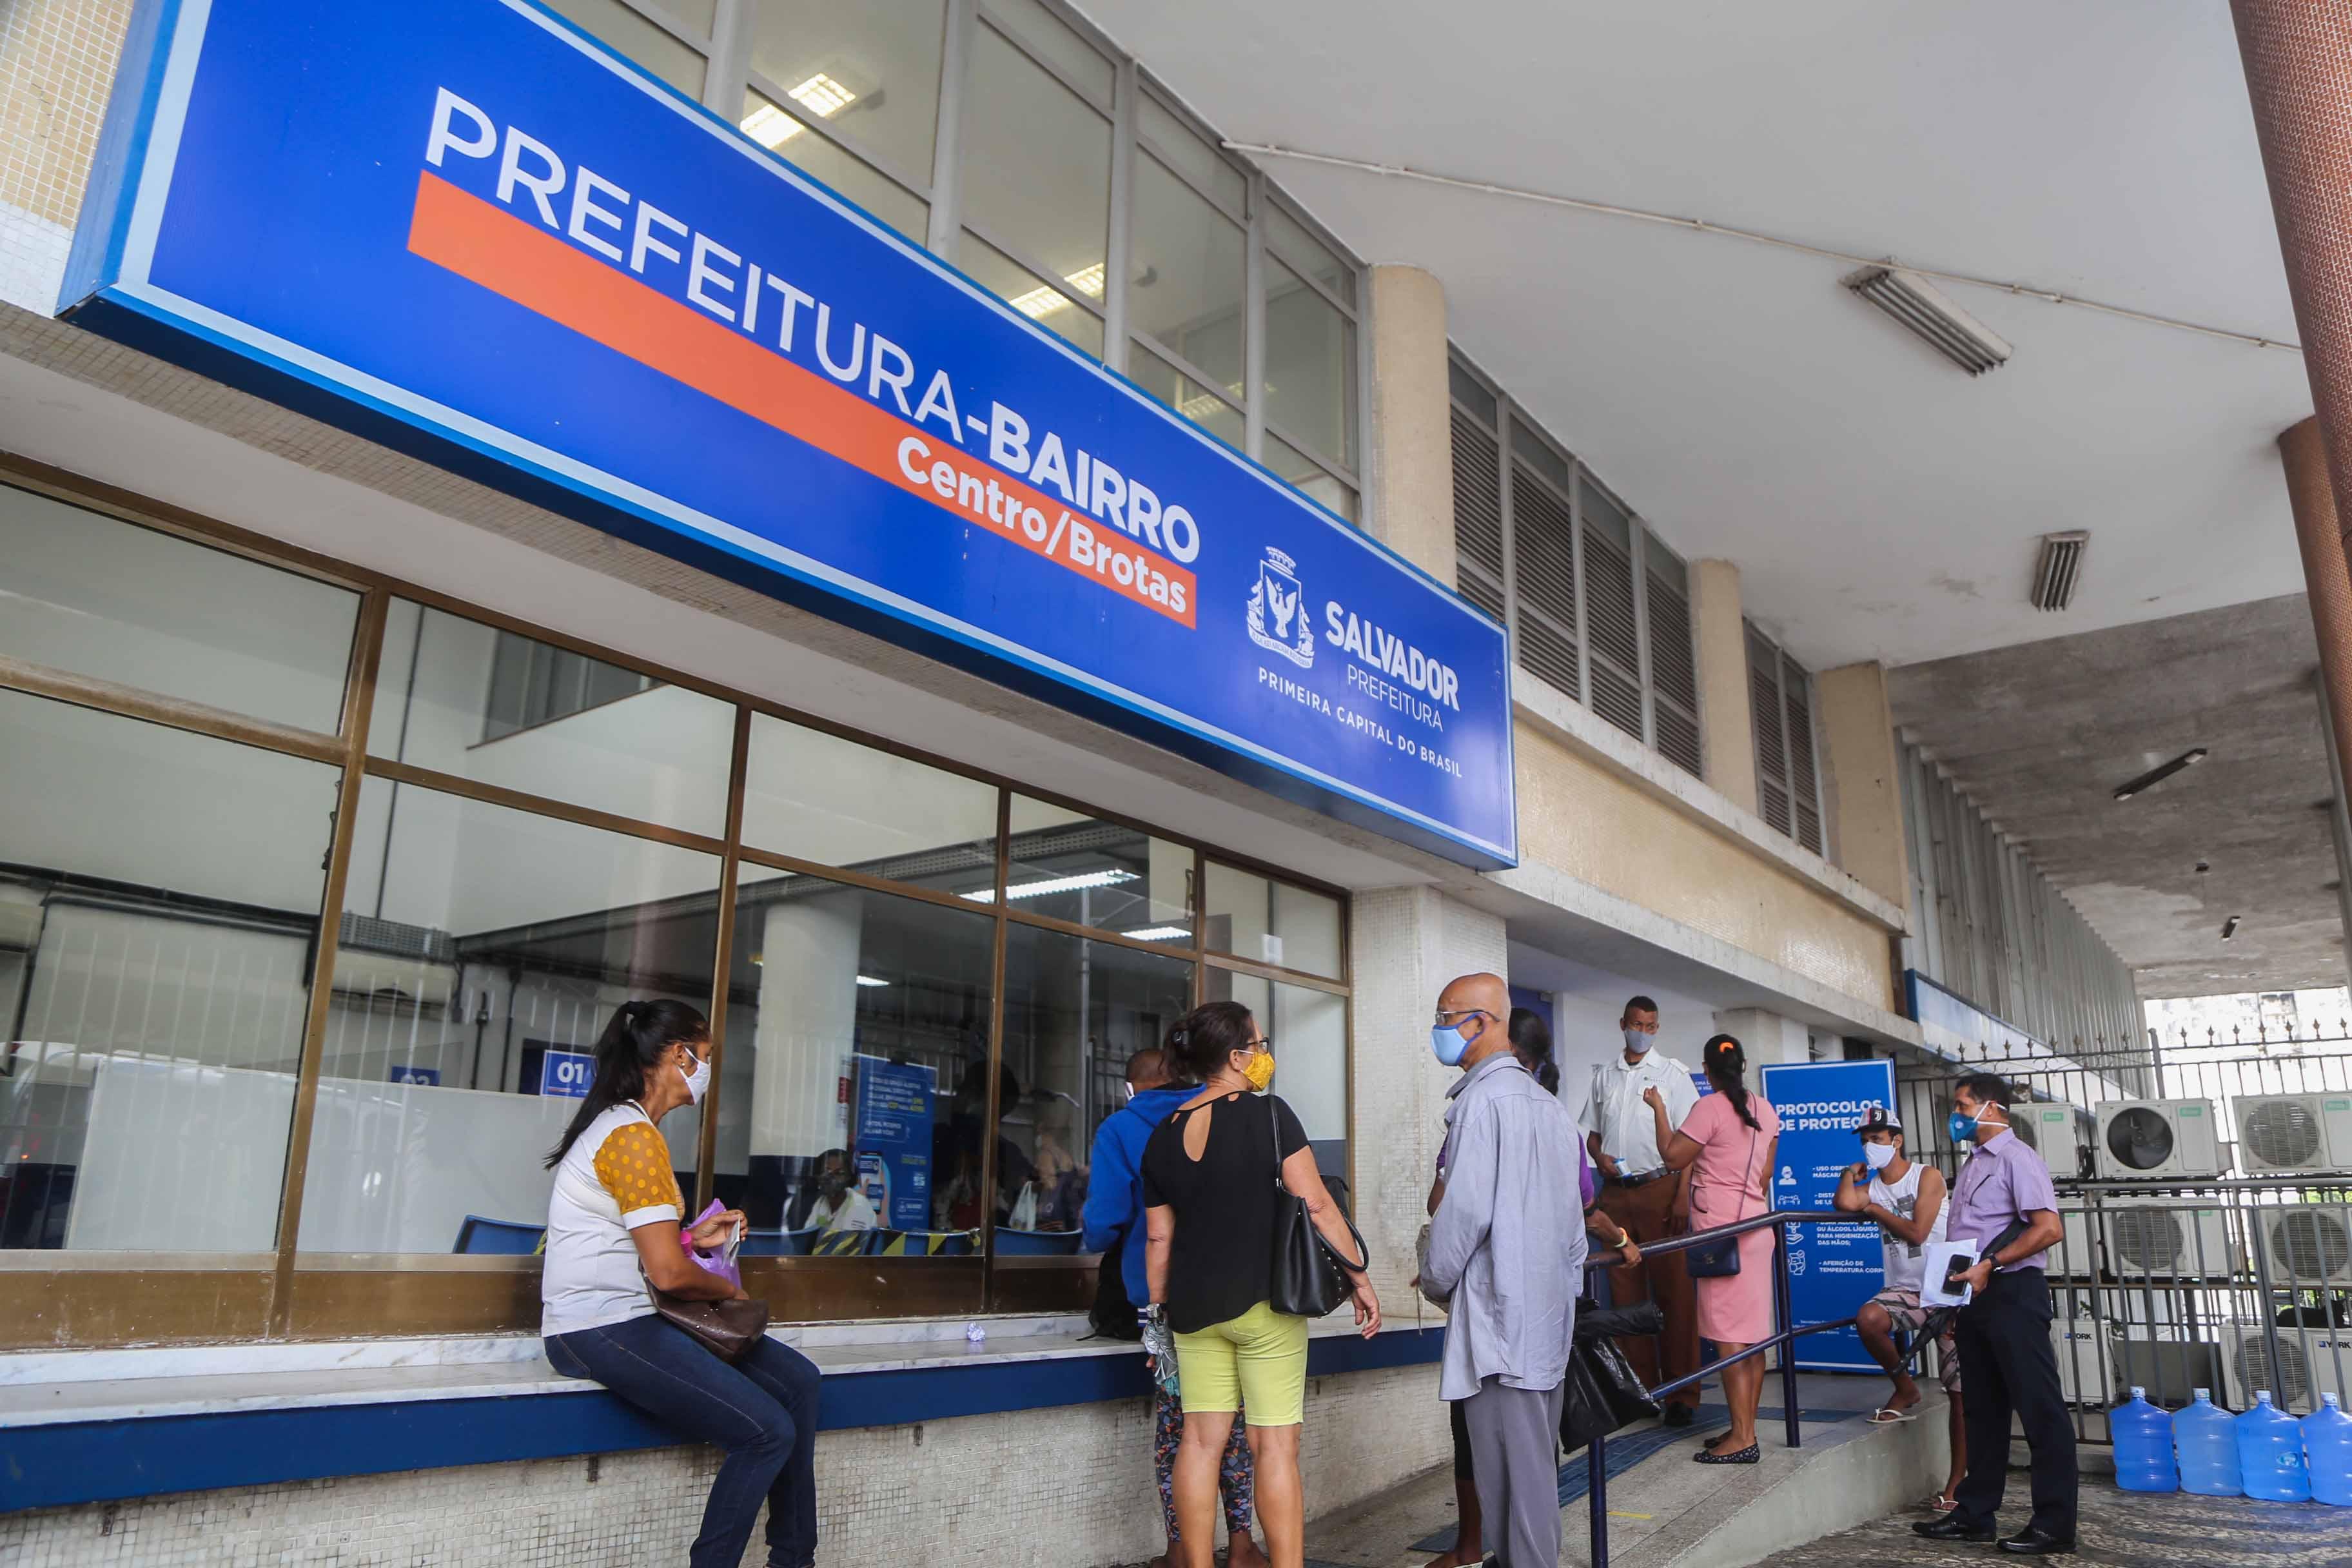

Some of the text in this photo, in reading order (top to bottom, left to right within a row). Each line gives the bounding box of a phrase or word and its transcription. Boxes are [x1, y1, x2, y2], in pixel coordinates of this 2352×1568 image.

[425, 86, 1200, 564] PREFEITURA-BAIRRO
[897, 436, 1187, 614] Centro/Brotas
[1326, 600, 1460, 711] SALVADOR
[1347, 663, 1444, 732] PREFEITURA
[1259, 666, 1463, 778] PRIMEIRA CAPITAL DO BRASIL
[557, 1061, 584, 1084] 01
[1776, 1099, 1883, 1115] PROTOCOLOS
[2326, 1340, 2351, 1349] YRK
